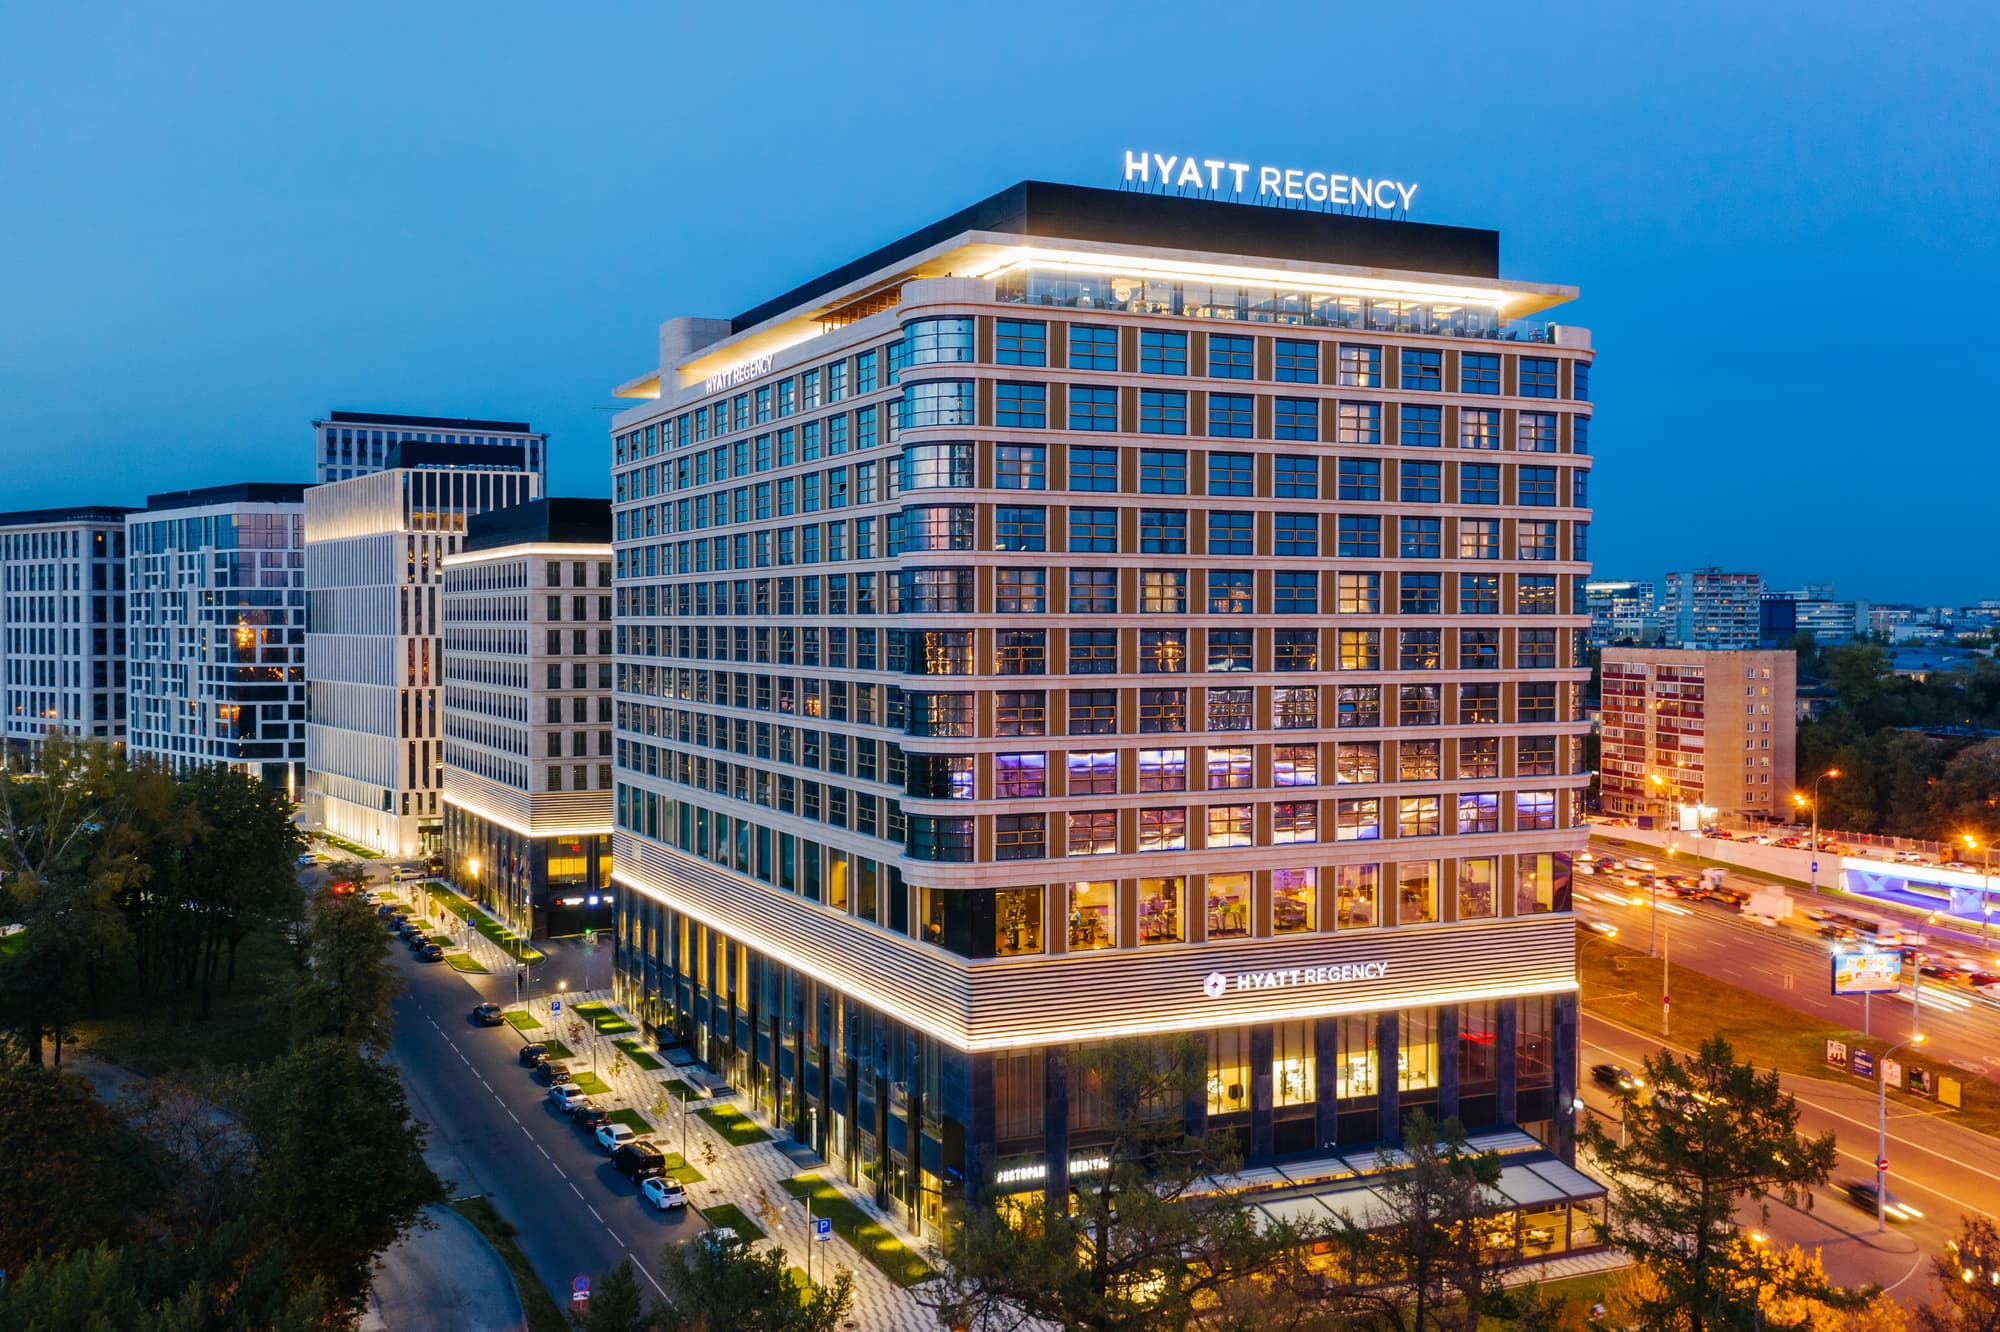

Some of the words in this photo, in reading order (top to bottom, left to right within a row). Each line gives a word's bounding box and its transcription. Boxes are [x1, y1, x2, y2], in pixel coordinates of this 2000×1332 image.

[1125, 150, 1249, 192] HYATT
[1260, 166, 1418, 211] REGENCY
[706, 370, 732, 394] HYATT
[734, 353, 774, 385] REGENCY
[1237, 970, 1300, 991] HYATT
[1304, 962, 1388, 984] REGENCY
[820, 1221, 829, 1233] P
